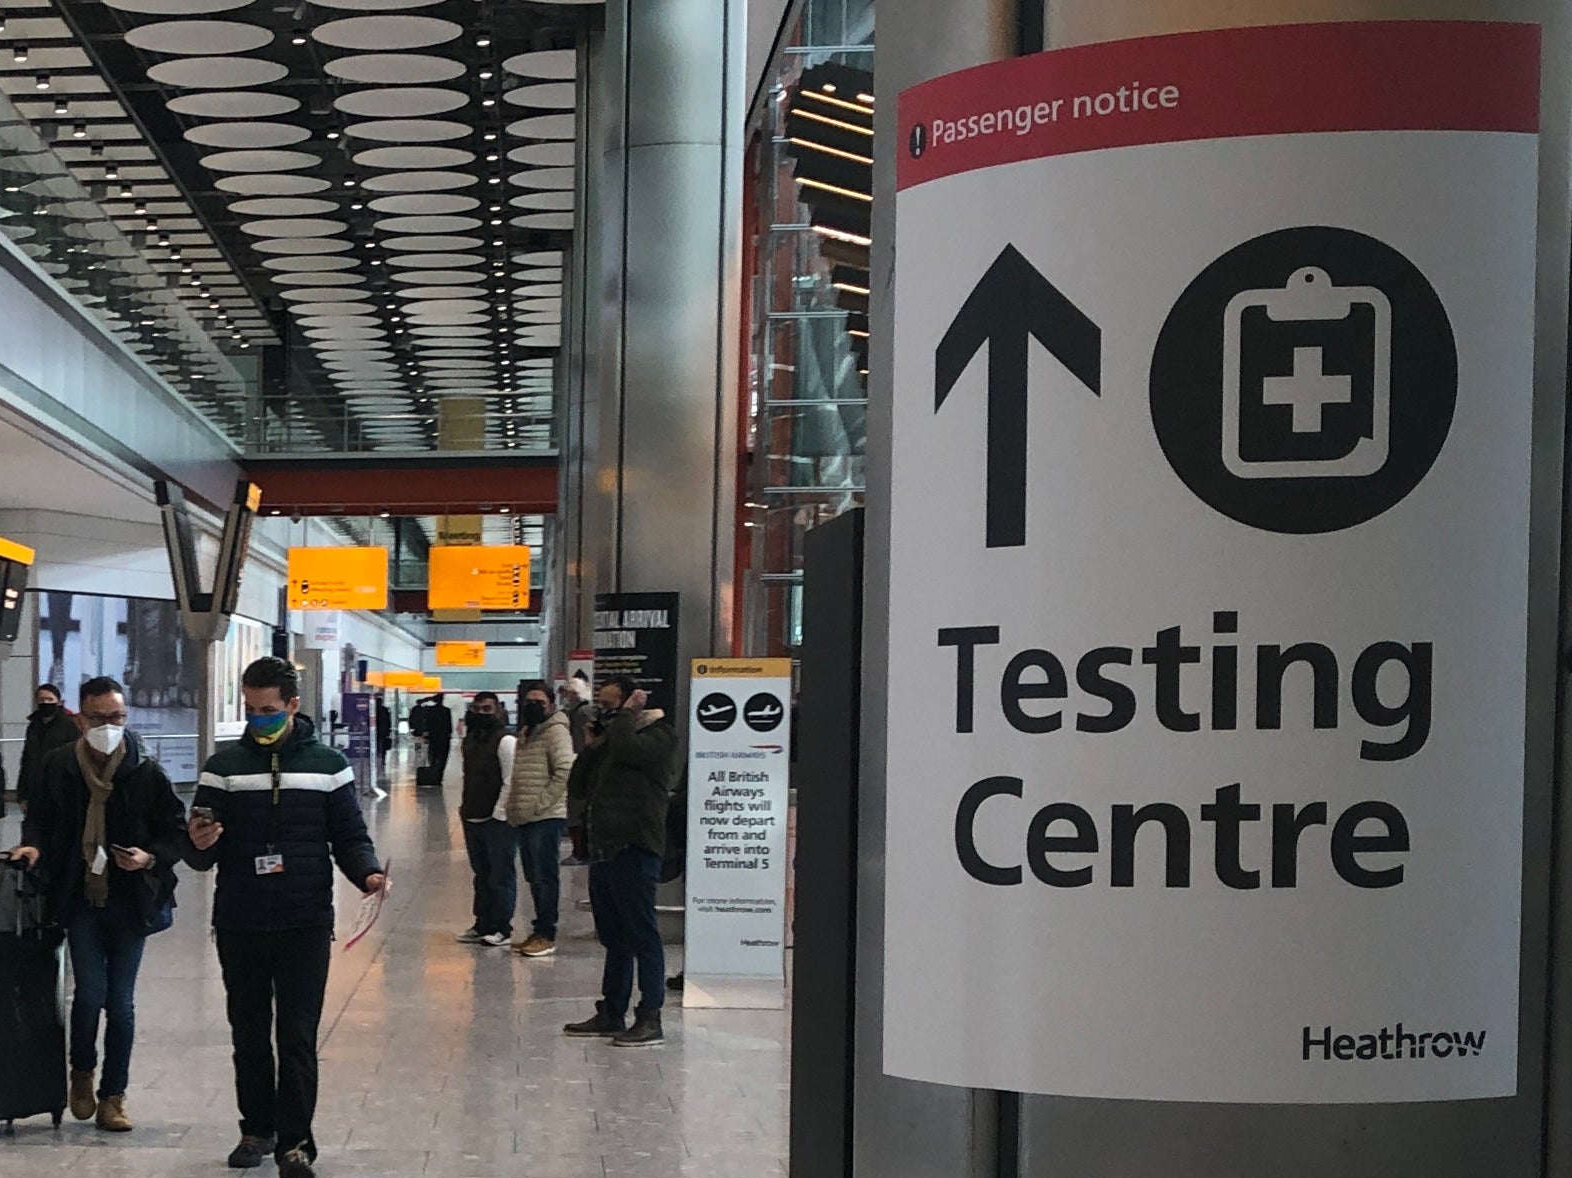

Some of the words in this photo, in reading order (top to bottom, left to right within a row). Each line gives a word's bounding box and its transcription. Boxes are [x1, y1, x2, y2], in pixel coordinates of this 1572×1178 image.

[932, 99, 1064, 147] Passenger
[1073, 81, 1180, 119] notice
[937, 610, 1434, 762] Testing
[708, 771, 725, 782] All
[728, 771, 769, 782] British
[712, 786, 764, 800] Airways
[704, 800, 745, 814] flights
[747, 800, 772, 811] will
[699, 816, 730, 826] now
[732, 815, 775, 828] depart
[708, 829, 738, 840] from
[742, 829, 766, 840] and
[954, 775, 1411, 891] Centre
[703, 844, 741, 855] arrive
[743, 844, 770, 855] into
[703, 857, 759, 869] Terminal
[761, 858, 770, 869] 5
[1302, 1022, 1487, 1061] Heathrow
